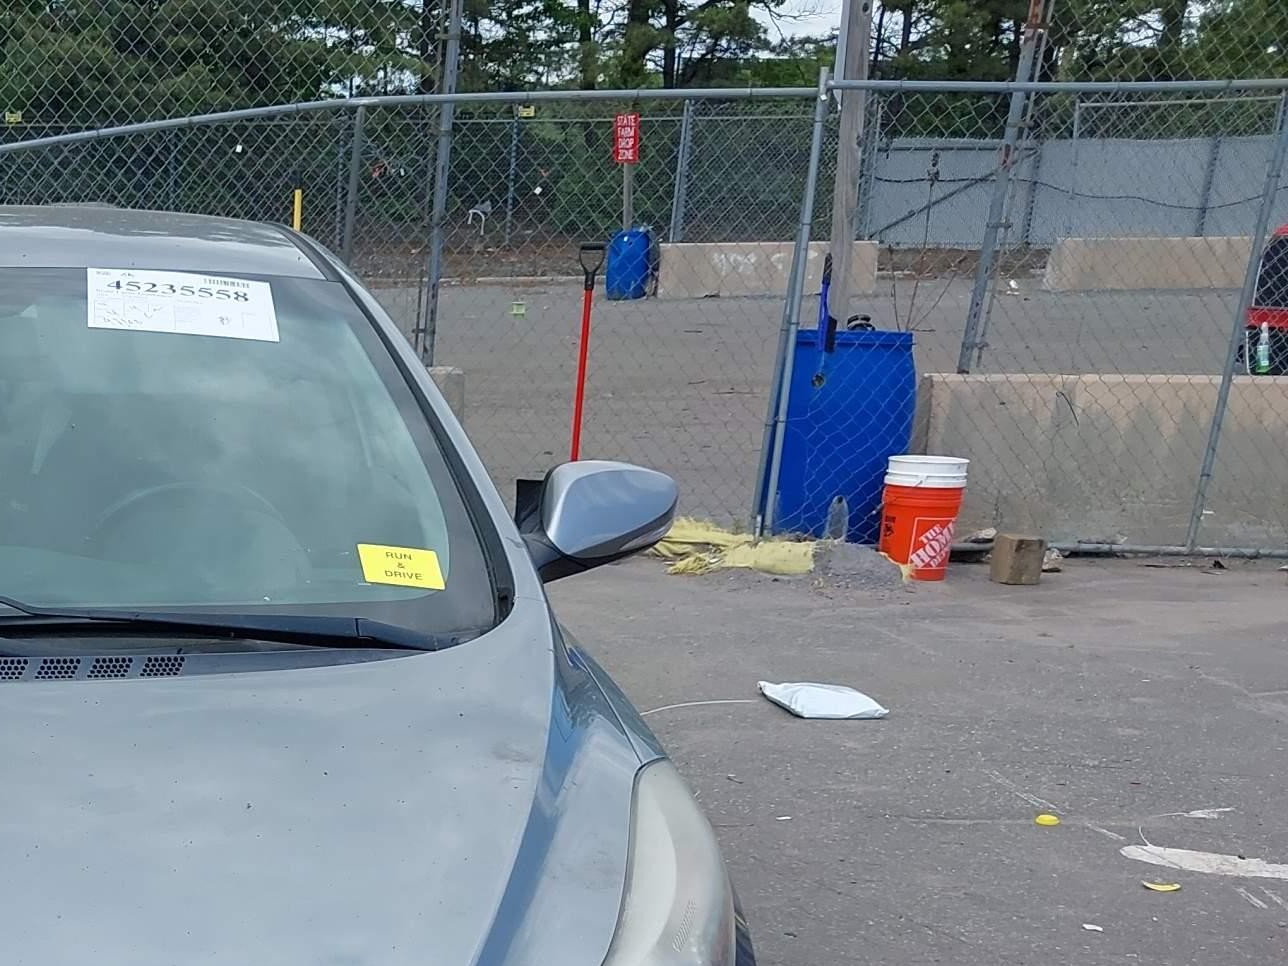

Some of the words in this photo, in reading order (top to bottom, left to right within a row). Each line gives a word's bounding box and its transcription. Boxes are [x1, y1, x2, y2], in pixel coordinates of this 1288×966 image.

[617, 115, 636, 126] STATE
[617, 127, 635, 137] FARM
[618, 138, 634, 149] DROP
[618, 149, 634, 160] ZONE
[106, 280, 249, 302] 45235558
[919, 523, 943, 545] THE
[385, 551, 412, 561] RUN
[384, 570, 423, 581] DRIVE
